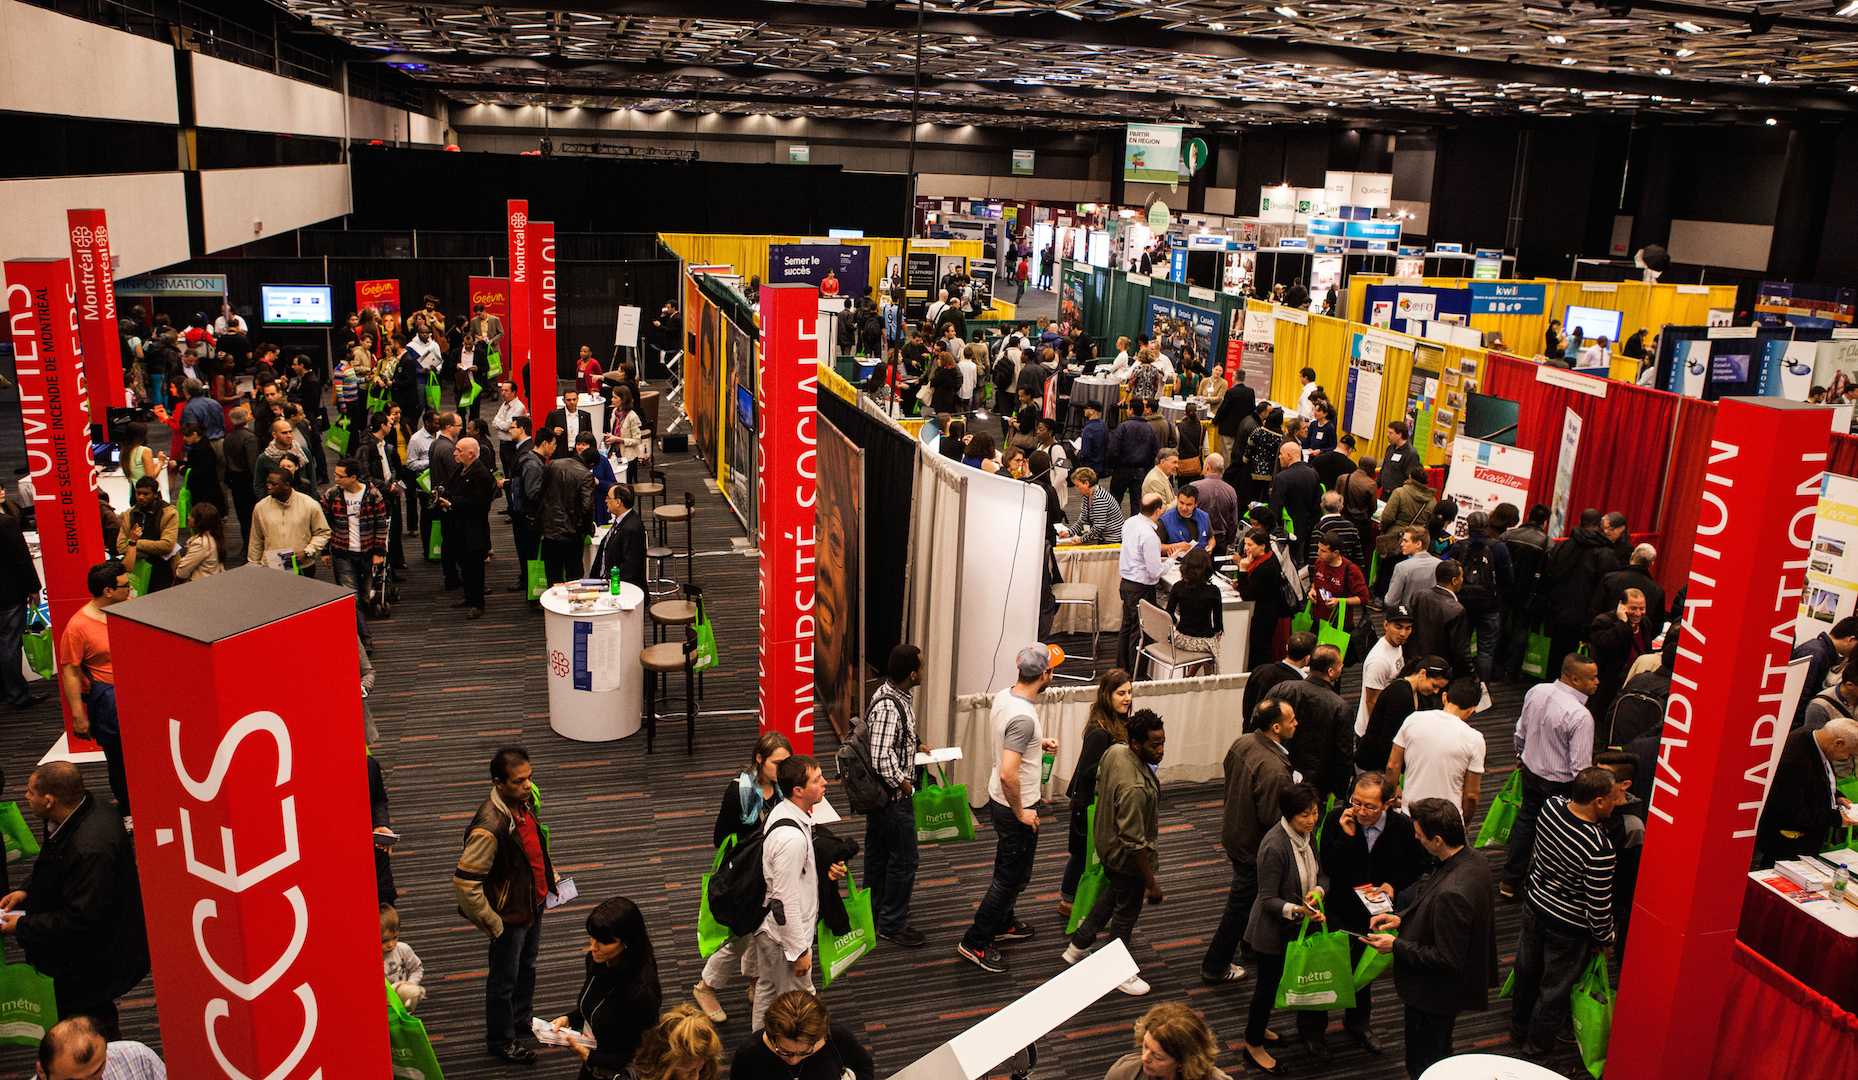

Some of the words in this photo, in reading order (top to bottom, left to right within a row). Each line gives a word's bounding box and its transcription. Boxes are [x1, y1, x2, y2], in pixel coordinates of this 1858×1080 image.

[1270, 201, 1294, 210] Desjardins
[514, 230, 526, 282] Montréal
[784, 256, 809, 266] Semer
[811, 256, 820, 265] le
[784, 266, 811, 276] succès
[77, 249, 99, 320] Montréal
[98, 248, 115, 319] Montréal
[122, 279, 215, 290] INFORMATION
[1496, 286, 1518, 296] kiwili
[34, 286, 54, 353] MONTRÉAL
[888, 313, 893, 323] 9
[1152, 304, 1170, 313] Kingston
[1178, 310, 1191, 319] Ontario
[1200, 316, 1214, 326] Canada
[44, 356, 57, 372] DE
[47, 376, 64, 430] INCENDIE
[51, 434, 71, 486] SÉCURITÉ
[1476, 468, 1522, 488] Travailler
[60, 491, 72, 504] DE
[1818, 502, 1857, 524] Vivre
[64, 509, 79, 554] SERVICE
[1813, 551, 1833, 562] Santé
[926, 812, 954, 822] métro
[154, 710, 322, 1080] CCÈS
[1298, 971, 1332, 984] métro
[2, 998, 41, 1013] métro
